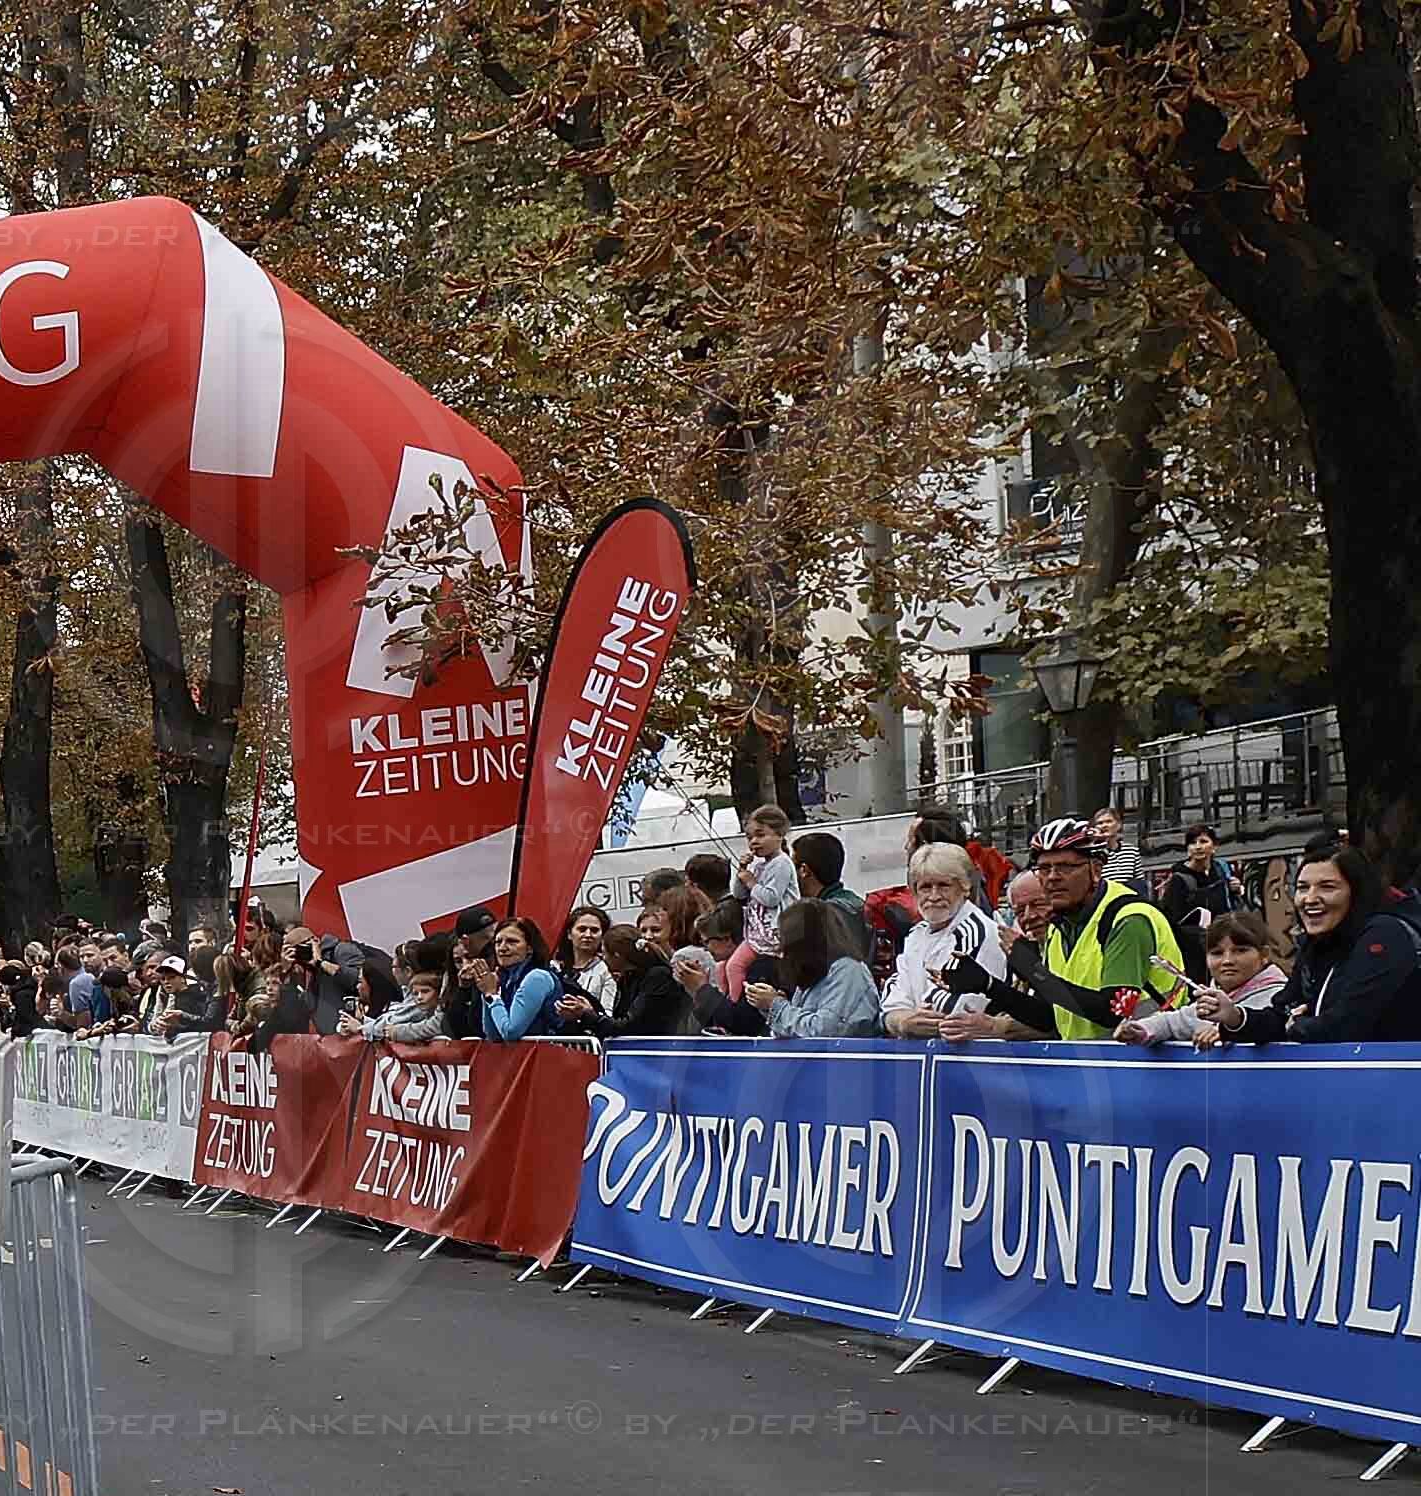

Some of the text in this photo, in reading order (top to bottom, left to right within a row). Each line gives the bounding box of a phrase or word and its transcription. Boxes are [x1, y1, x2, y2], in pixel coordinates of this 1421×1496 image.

[554, 575, 652, 778] KLEINE
[581, 588, 678, 790] ZEITUNG
[349, 698, 526, 755] KLEINE
[15, 1050, 48, 1099] RAZ
[210, 1050, 279, 1110] KLEINE
[368, 1056, 472, 1132] KLEINE
[354, 1127, 466, 1214] ZEITUNG
[943, 1113, 1421, 1338] PUNTIGAME
